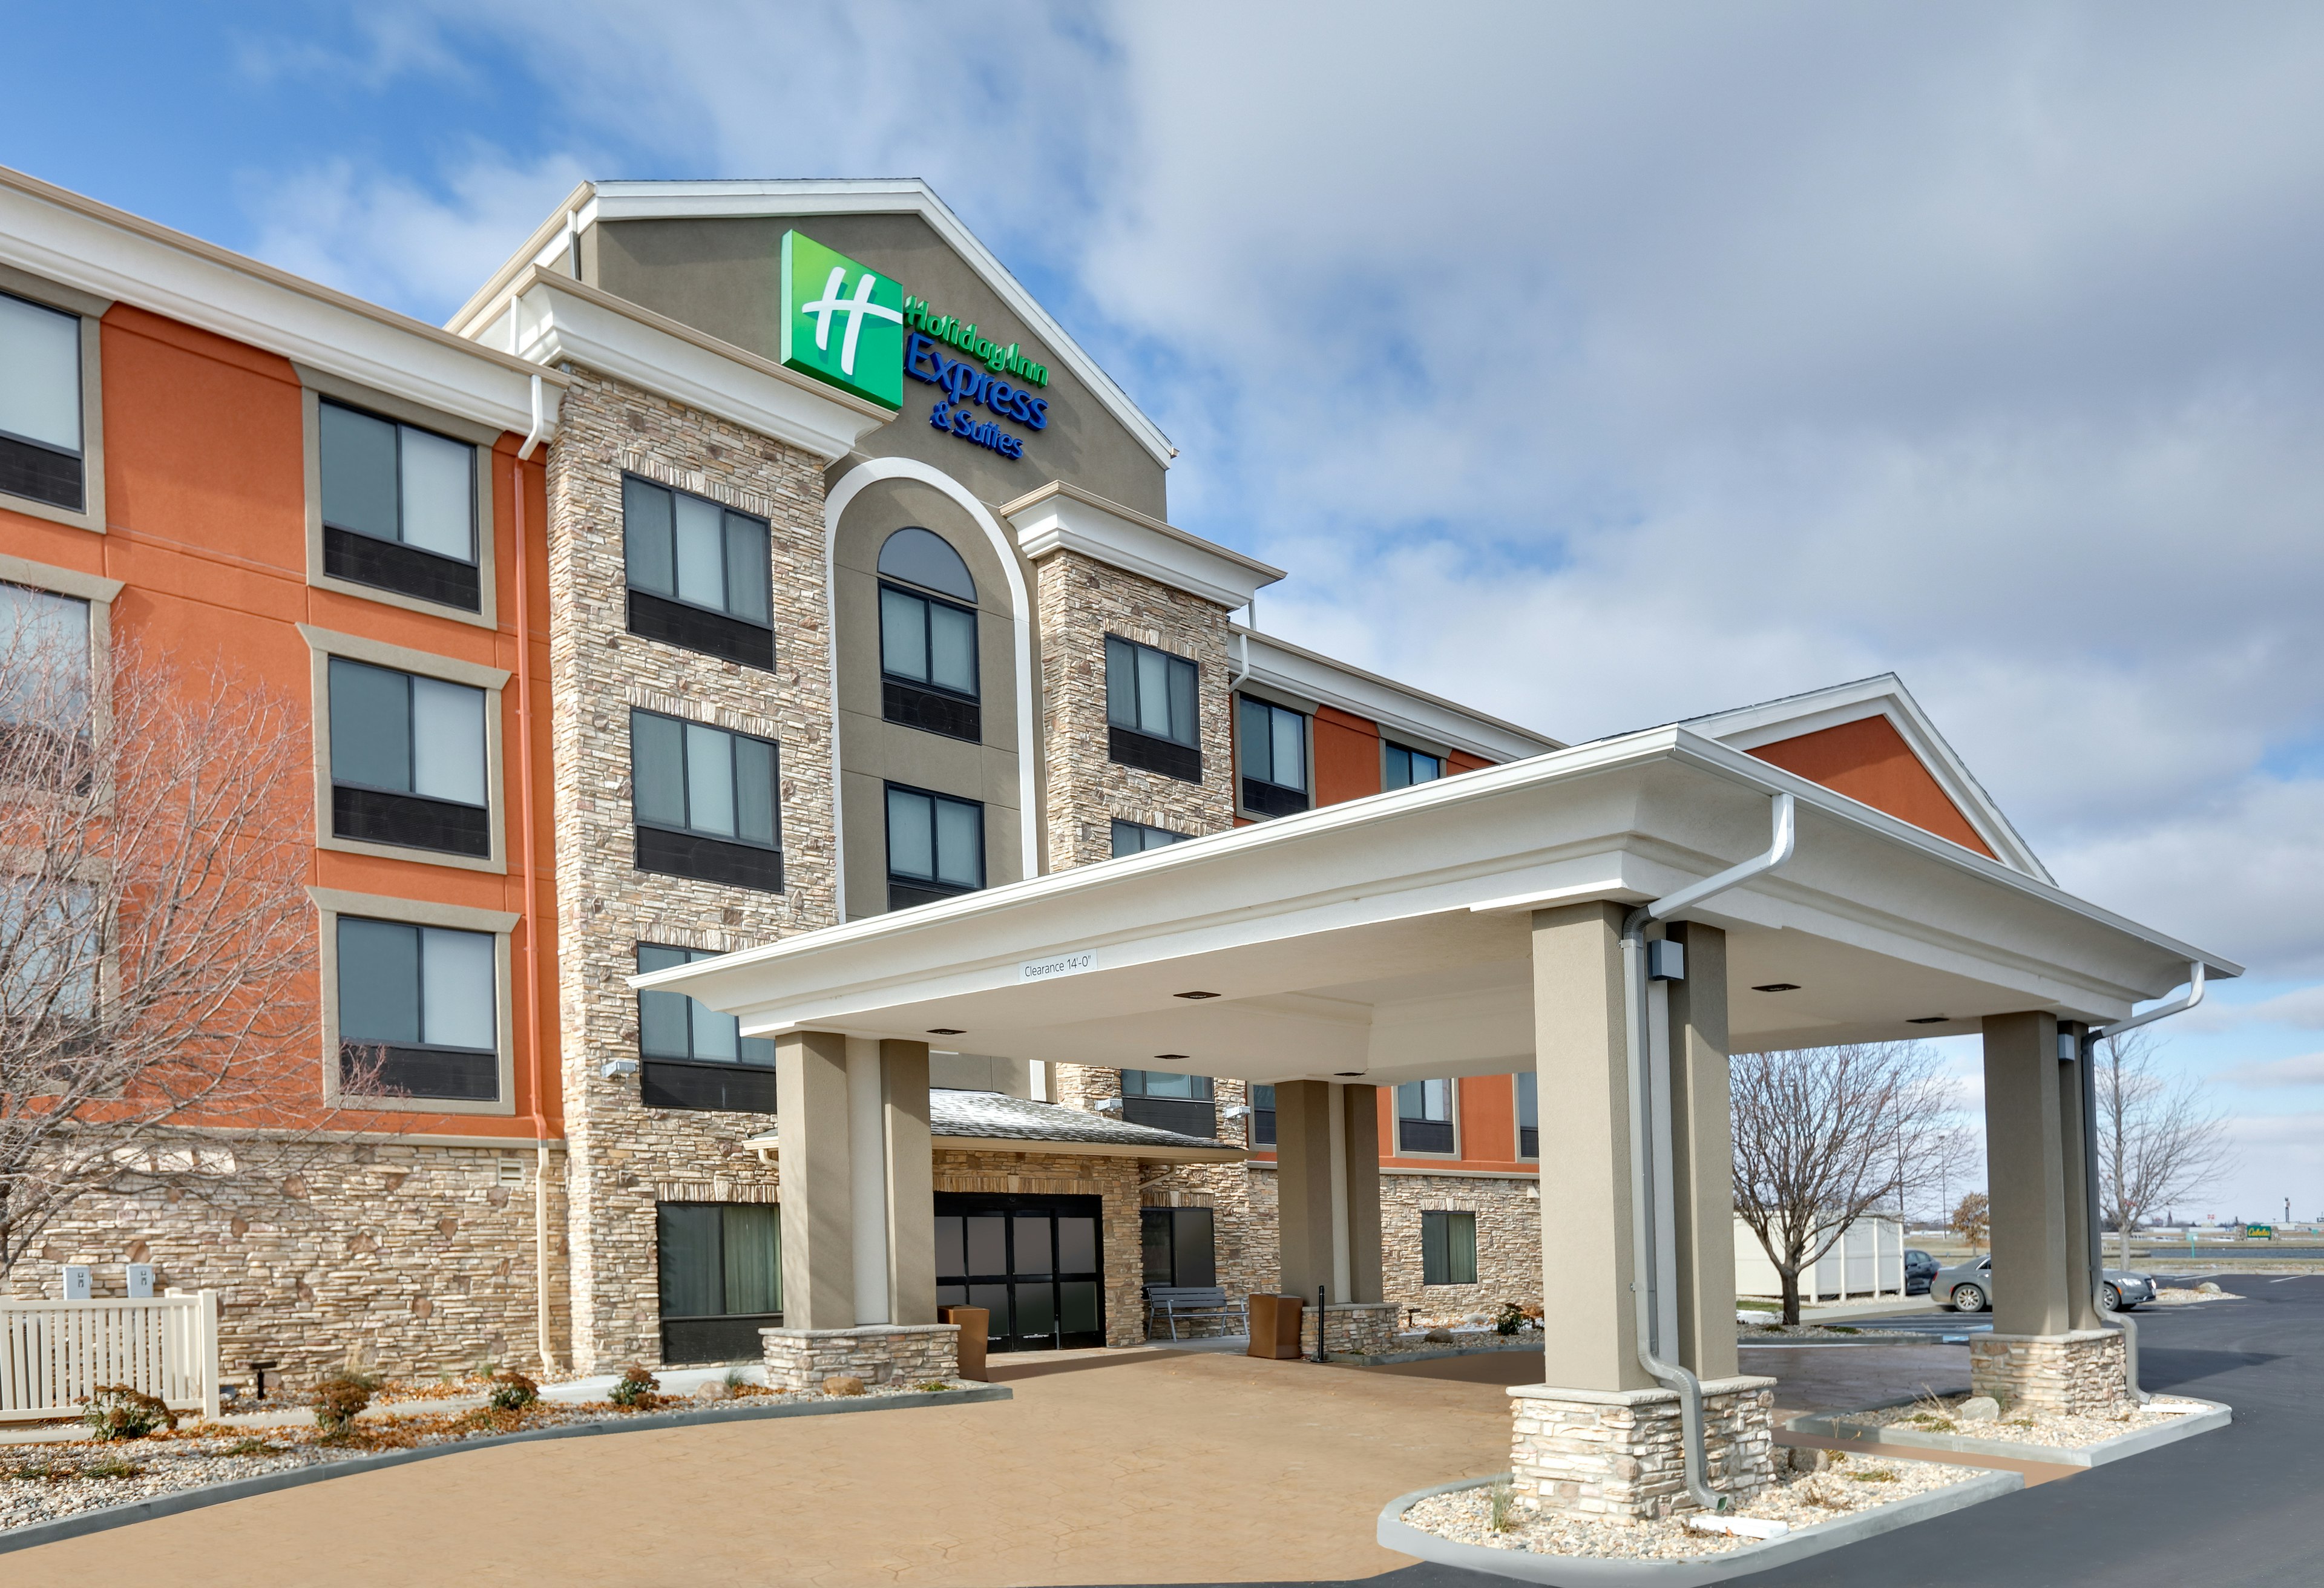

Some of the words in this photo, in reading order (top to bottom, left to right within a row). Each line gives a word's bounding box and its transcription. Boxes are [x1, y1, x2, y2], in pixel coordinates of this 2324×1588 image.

[904, 331, 1048, 431] Express
[929, 400, 952, 433] &
[951, 409, 1023, 461] Suites
[1025, 962, 1065, 977] Clearance
